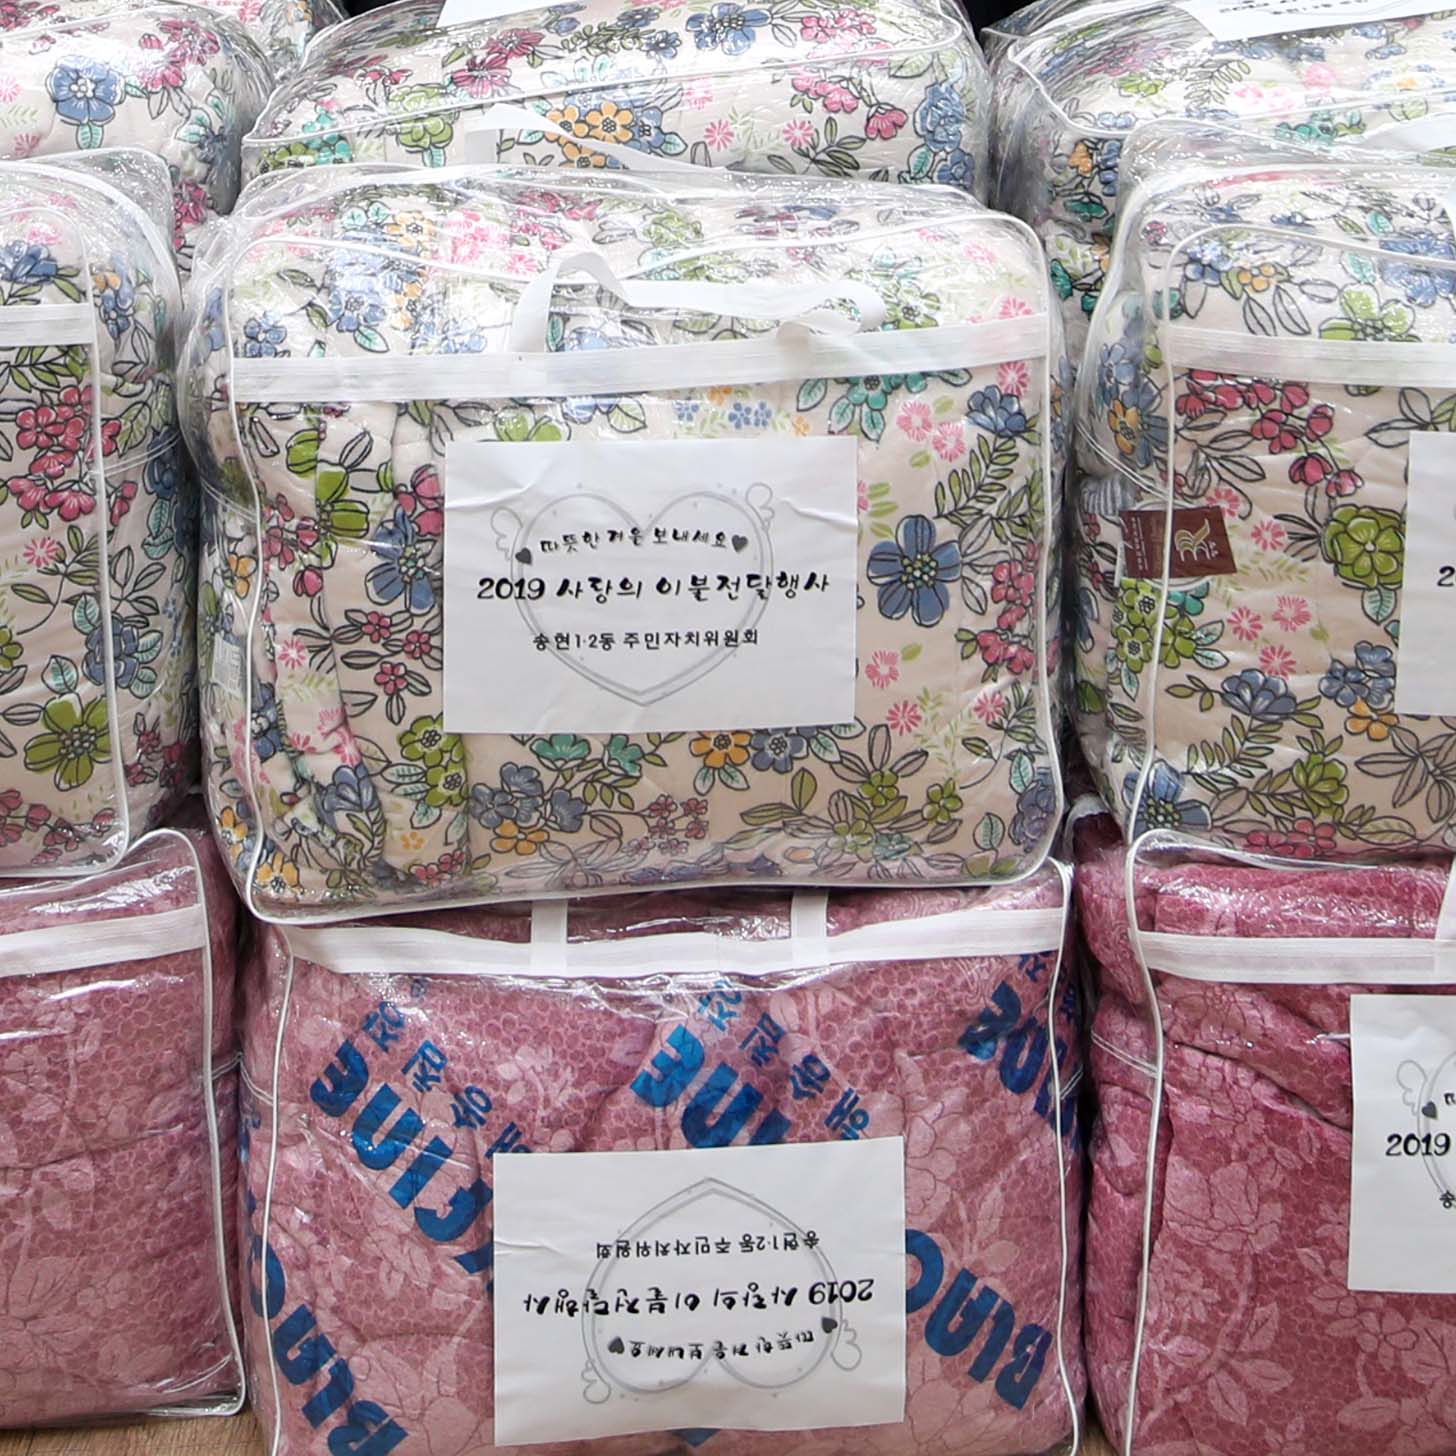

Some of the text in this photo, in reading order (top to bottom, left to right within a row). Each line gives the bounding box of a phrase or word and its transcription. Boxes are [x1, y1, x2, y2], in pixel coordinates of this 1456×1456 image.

[540, 531, 599, 553] 따뜻한
[654, 527, 726, 547] 보내세요
[477, 571, 829, 604] 2019 사랑의 이불전달행사
[533, 629, 758, 652] 송현1·2동 주민자치위원회
[1385, 1132, 1451, 1157] 2019
[808, 1278, 875, 1305] 2019
